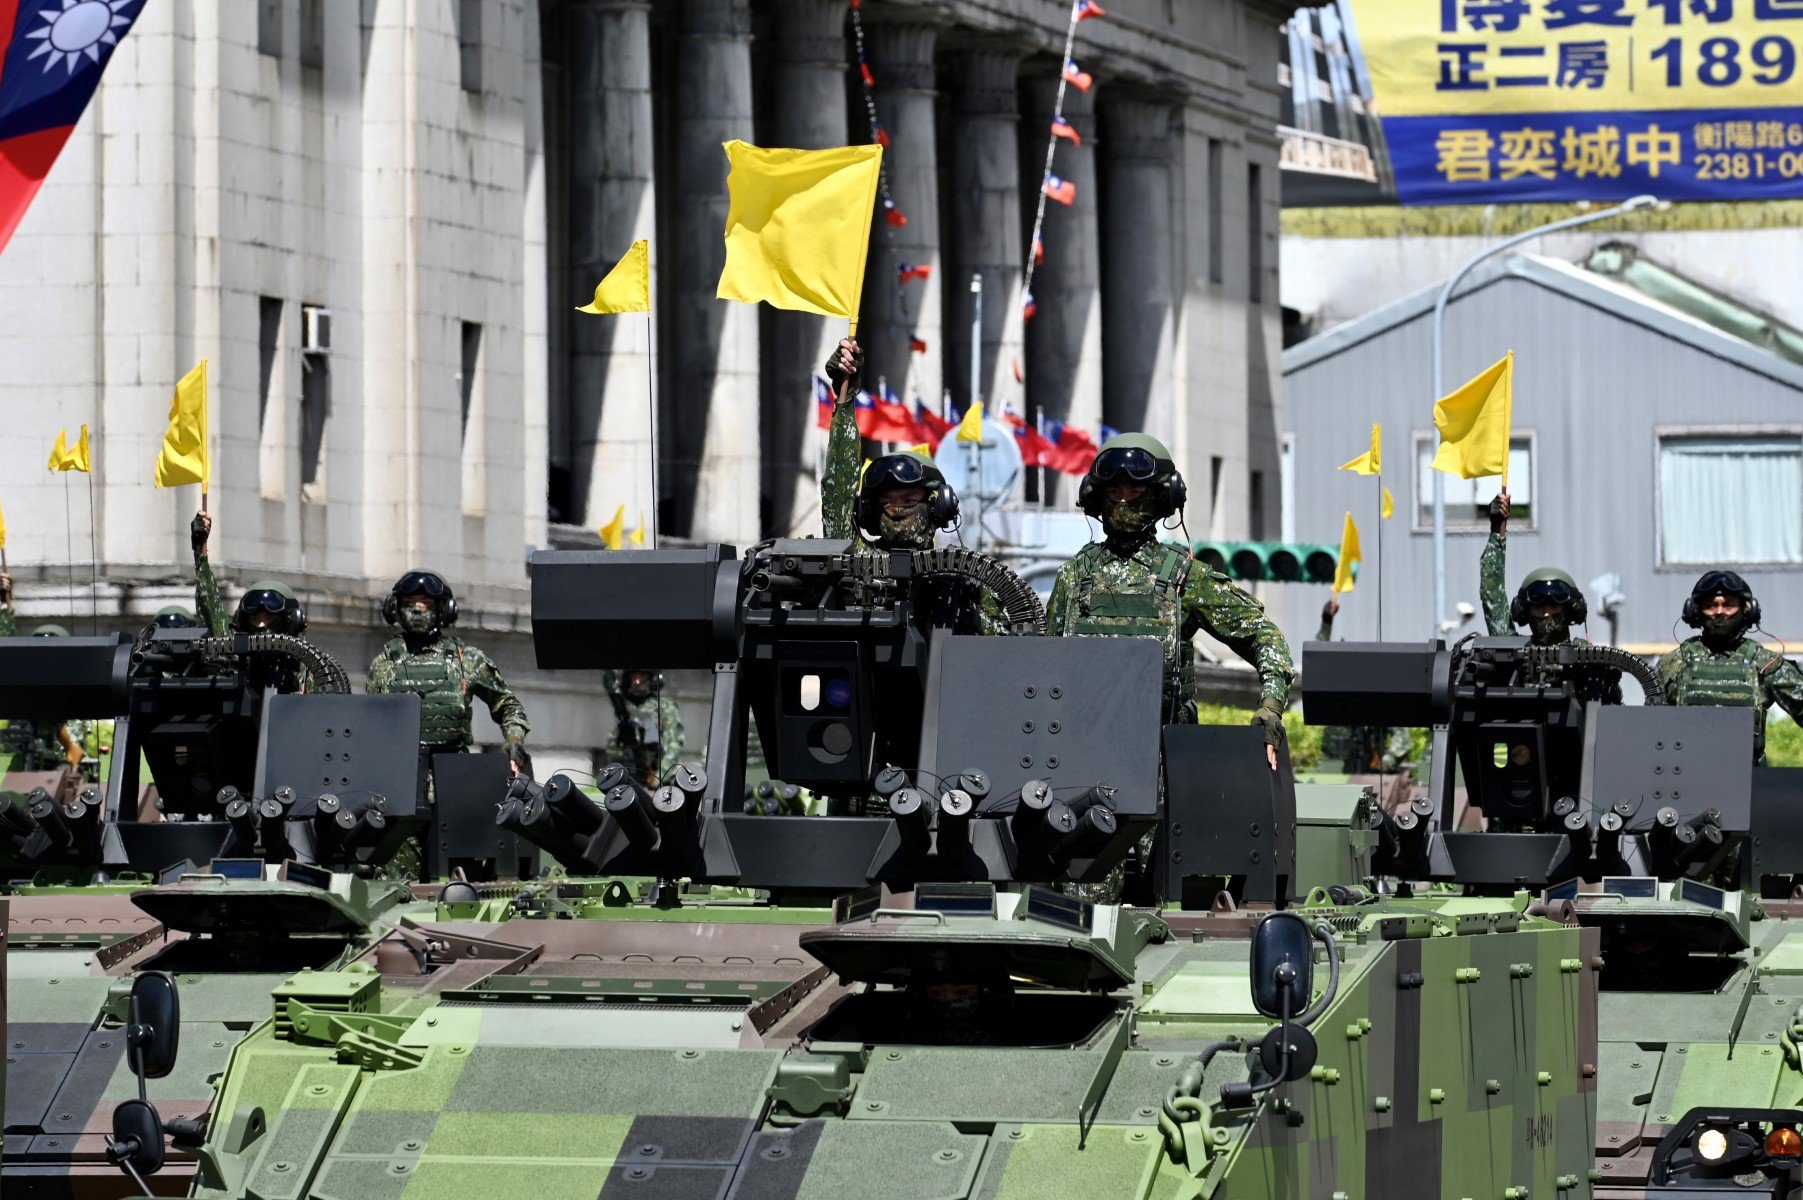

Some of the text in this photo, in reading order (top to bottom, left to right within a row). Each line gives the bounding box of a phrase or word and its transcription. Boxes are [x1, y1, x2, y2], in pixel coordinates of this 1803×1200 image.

[1436, 36, 1796, 91] 正二房 189
[1435, 124, 1681, 182] 君奕城中
